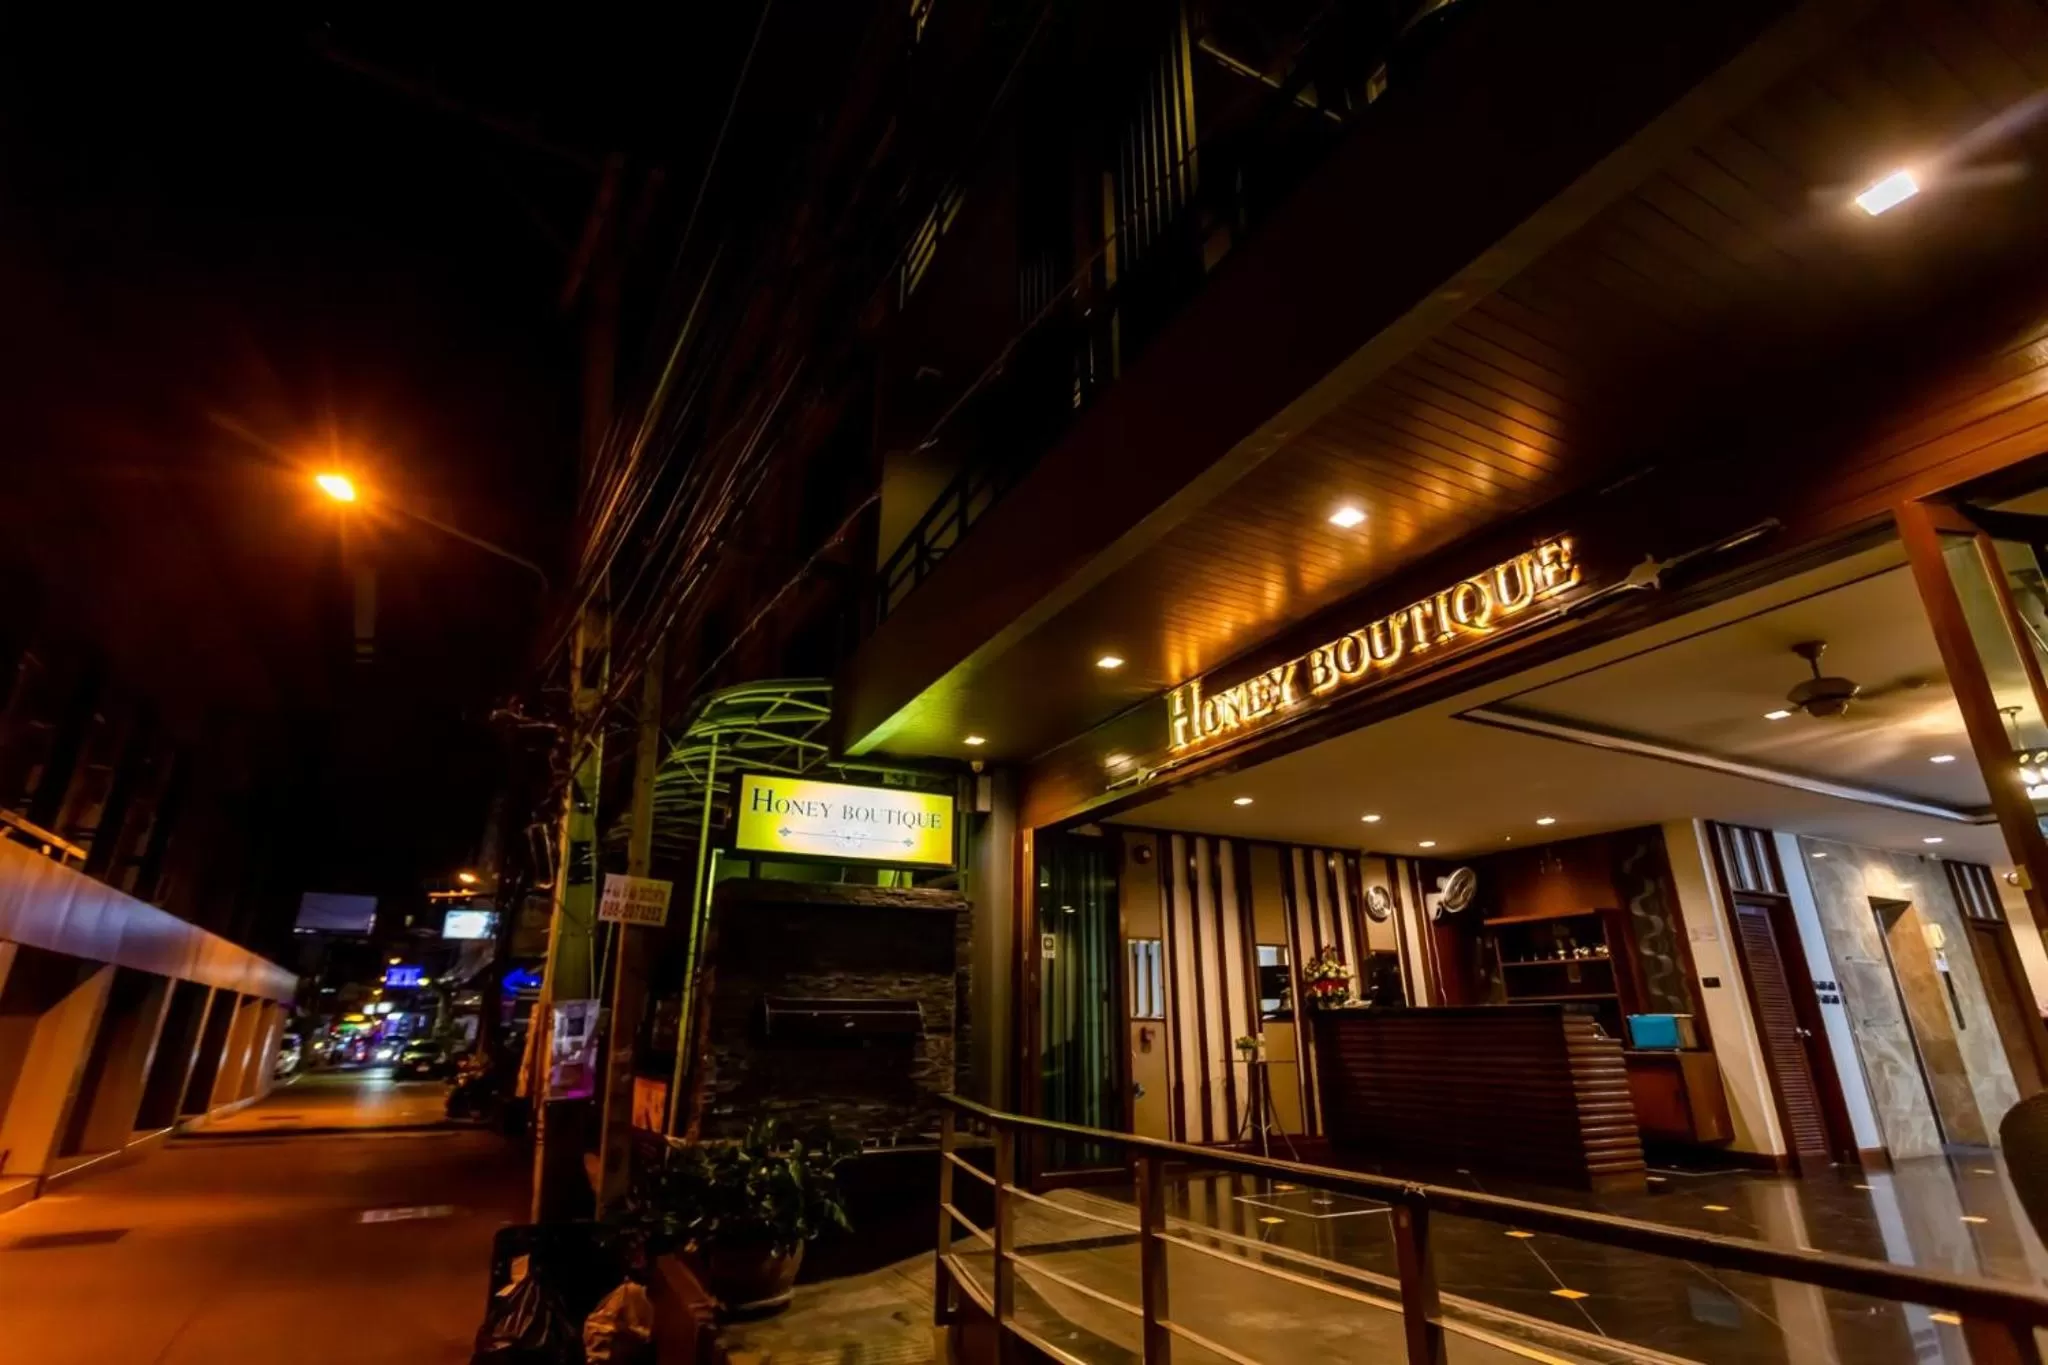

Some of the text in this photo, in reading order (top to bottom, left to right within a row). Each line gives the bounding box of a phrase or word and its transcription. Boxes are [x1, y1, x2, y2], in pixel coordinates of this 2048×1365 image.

[1166, 536, 1581, 751] HONEY BOUTIQUE
[752, 788, 942, 830] HONEY BOUTIQUE
